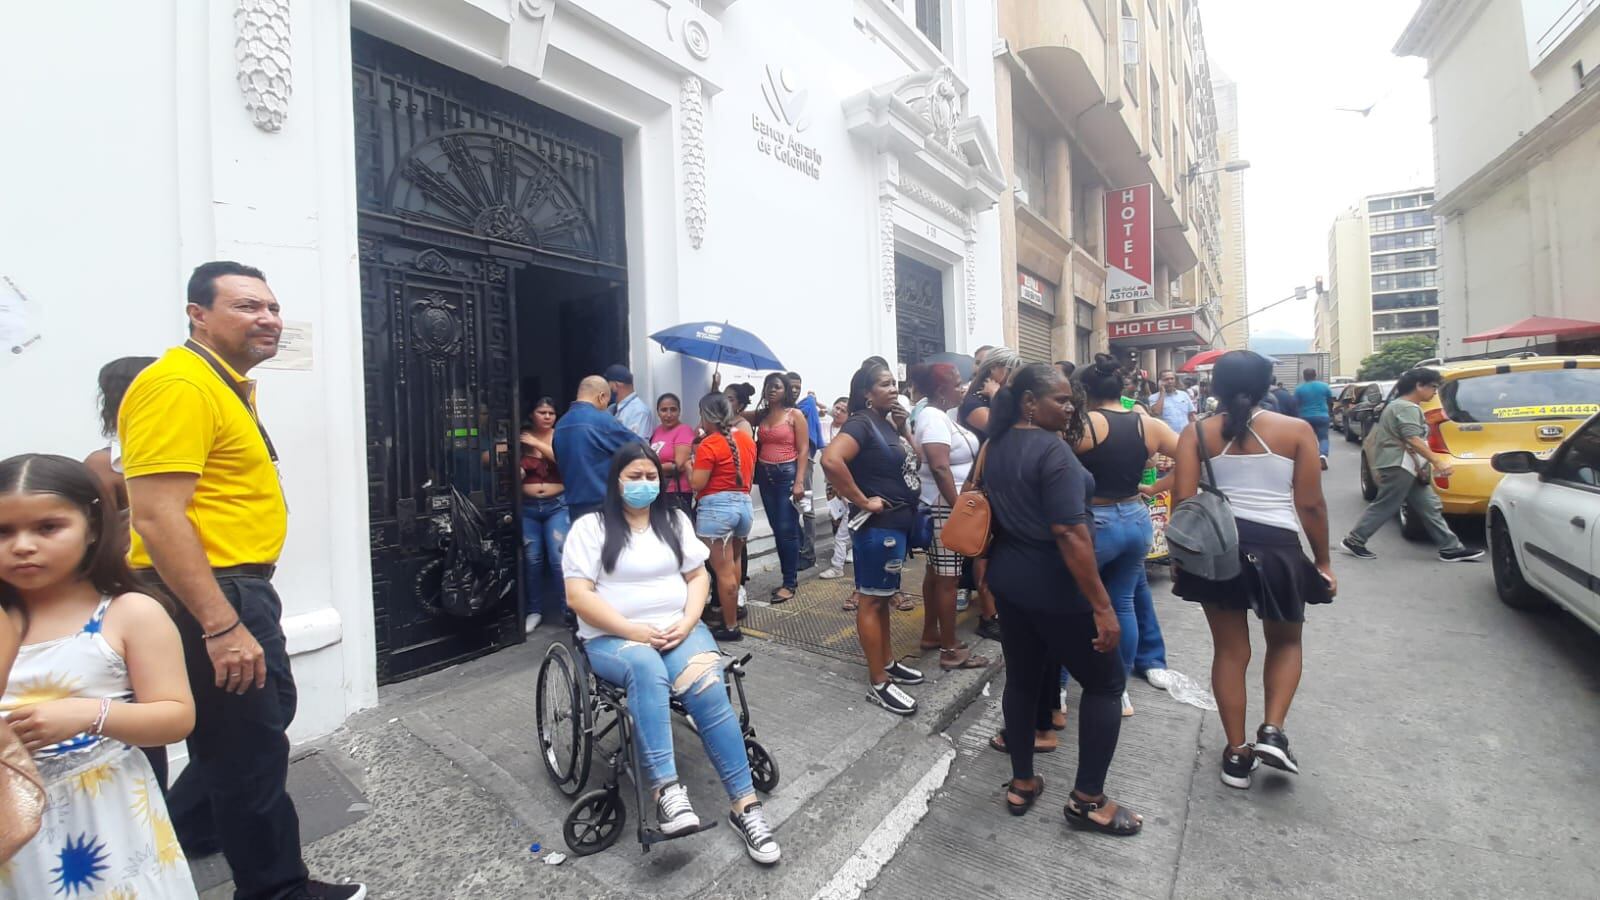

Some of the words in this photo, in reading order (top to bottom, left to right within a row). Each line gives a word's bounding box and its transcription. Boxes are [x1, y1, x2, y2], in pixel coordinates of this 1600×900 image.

[752, 112, 785, 145] Banco
[787, 134, 822, 166] Agrario
[757, 137, 772, 155] de
[774, 144, 820, 181] Colombia
[1121, 189, 1135, 270] HOTEL
[1110, 290, 1149, 300] ASTORIA
[1115, 319, 1185, 335] HOTEL
